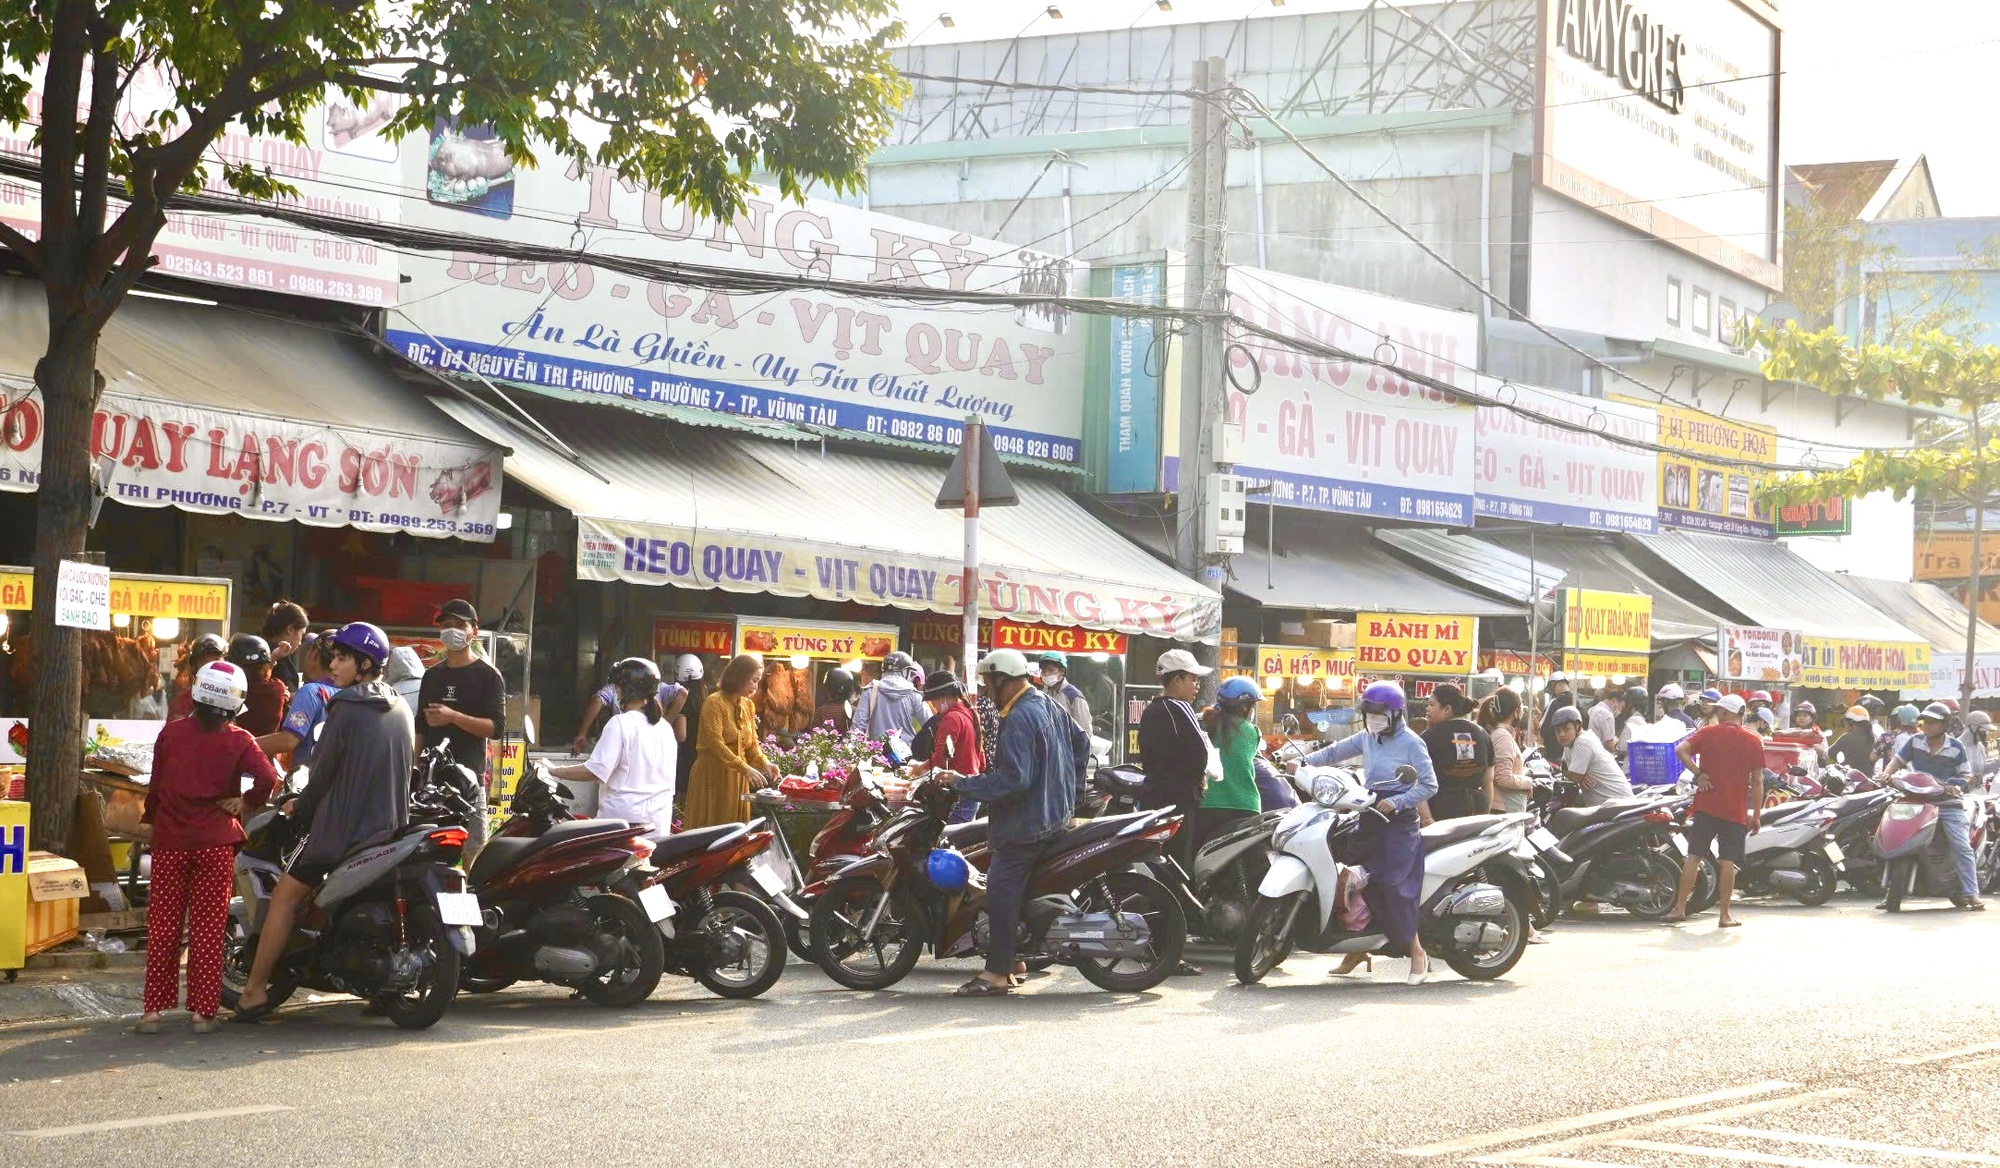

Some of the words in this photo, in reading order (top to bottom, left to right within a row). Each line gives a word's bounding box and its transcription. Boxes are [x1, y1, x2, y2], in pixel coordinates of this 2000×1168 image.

[262, 140, 323, 181] QUAY
[191, 214, 226, 241] QUAY
[241, 224, 261, 250] VỊT
[265, 233, 299, 254] QUAY
[165, 254, 243, 281] 02543.523
[248, 267, 273, 286] 861
[289, 273, 383, 301] 0989.253.369
[790, 298, 893, 361] VỊT
[905, 322, 1055, 385] QUAY
[573, 323, 621, 353] Là
[629, 333, 725, 371] Ghiền
[752, 352, 800, 388] Uy
[810, 361, 858, 393] Tín
[867, 372, 929, 404] Chất
[934, 385, 1014, 423] Lương
[407, 341, 435, 366] ĐC:
[469, 346, 538, 383] NGUYỄN
[543, 365, 567, 386] TRI
[571, 369, 634, 397] PHƯƠNG
[650, 377, 711, 407] PHƯỜNG
[715, 390, 724, 408] 7
[741, 393, 762, 417] TP.
[766, 395, 805, 421] VŨNG
[810, 401, 837, 427] TÀU
[867, 415, 888, 435] ĐT:
[891, 418, 924, 441] 0982
[927, 423, 944, 444] 86
[993, 434, 1023, 455] 0946
[1027, 438, 1048, 457] 926
[1052, 440, 1074, 461] 606
[1120, 378, 1133, 413] QUAN
[1119, 415, 1132, 452] THAM
[1278, 390, 1315, 459] GÀ
[1344, 410, 1387, 478] VỊT
[1394, 417, 1458, 477] QUAY
[1688, 421, 1739, 449] PHƯƠNG
[206, 427, 330, 496] LẠNG
[339, 440, 422, 501] SƠN
[1519, 450, 1546, 489] GÀ
[1566, 461, 1595, 502] VỊT
[1600, 468, 1646, 503] QUAY
[117, 482, 149, 499] TRI
[157, 487, 242, 511] PHƯƠNG
[263, 501, 289, 515] P.7
[308, 506, 330, 518] VT
[349, 510, 375, 524] ĐT:
[379, 513, 495, 536] 0989.253.369
[1332, 487, 1354, 508] VŨNG
[1355, 488, 1372, 509] TÀU
[1400, 497, 1412, 514] ĐT:
[1416, 500, 1463, 519] 0981654629
[1605, 513, 1652, 530] 0981654629
[1919, 551, 1960, 569] Trà
[3, 580, 26, 605] GÀ
[623, 536, 691, 577] HEO
[702, 543, 783, 583] QUAY
[815, 555, 858, 599] VỊT
[869, 562, 937, 602] QUAY
[1114, 595, 1183, 633] KÝ
[110, 587, 132, 611] GÀ
[139, 586, 173, 612] HẤP
[178, 589, 221, 615] MUỐI
[82, 610, 98, 626] BAO
[1369, 618, 1428, 639] BÁNH
[1435, 620, 1459, 640] MÌ
[1585, 607, 1607, 640] QUAY
[1607, 602, 1632, 637] HOÀNG
[1633, 611, 1649, 639] ANH
[659, 627, 700, 648] TÙNG
[704, 627, 728, 649] KÝ
[783, 633, 827, 652] TÙNG
[832, 636, 854, 653] KÝ
[1000, 623, 1075, 649] TÙNG
[1084, 628, 1121, 651] KÝ
[1264, 653, 1283, 675] GÀ
[1290, 653, 1320, 675] HẤP
[1359, 647, 1401, 663] HEO
[1407, 649, 1468, 667] QUAY
[1497, 656, 1509, 672] GÀ
[1839, 643, 1882, 671] PHƯƠNG
[200, 681, 229, 696] HDBank
